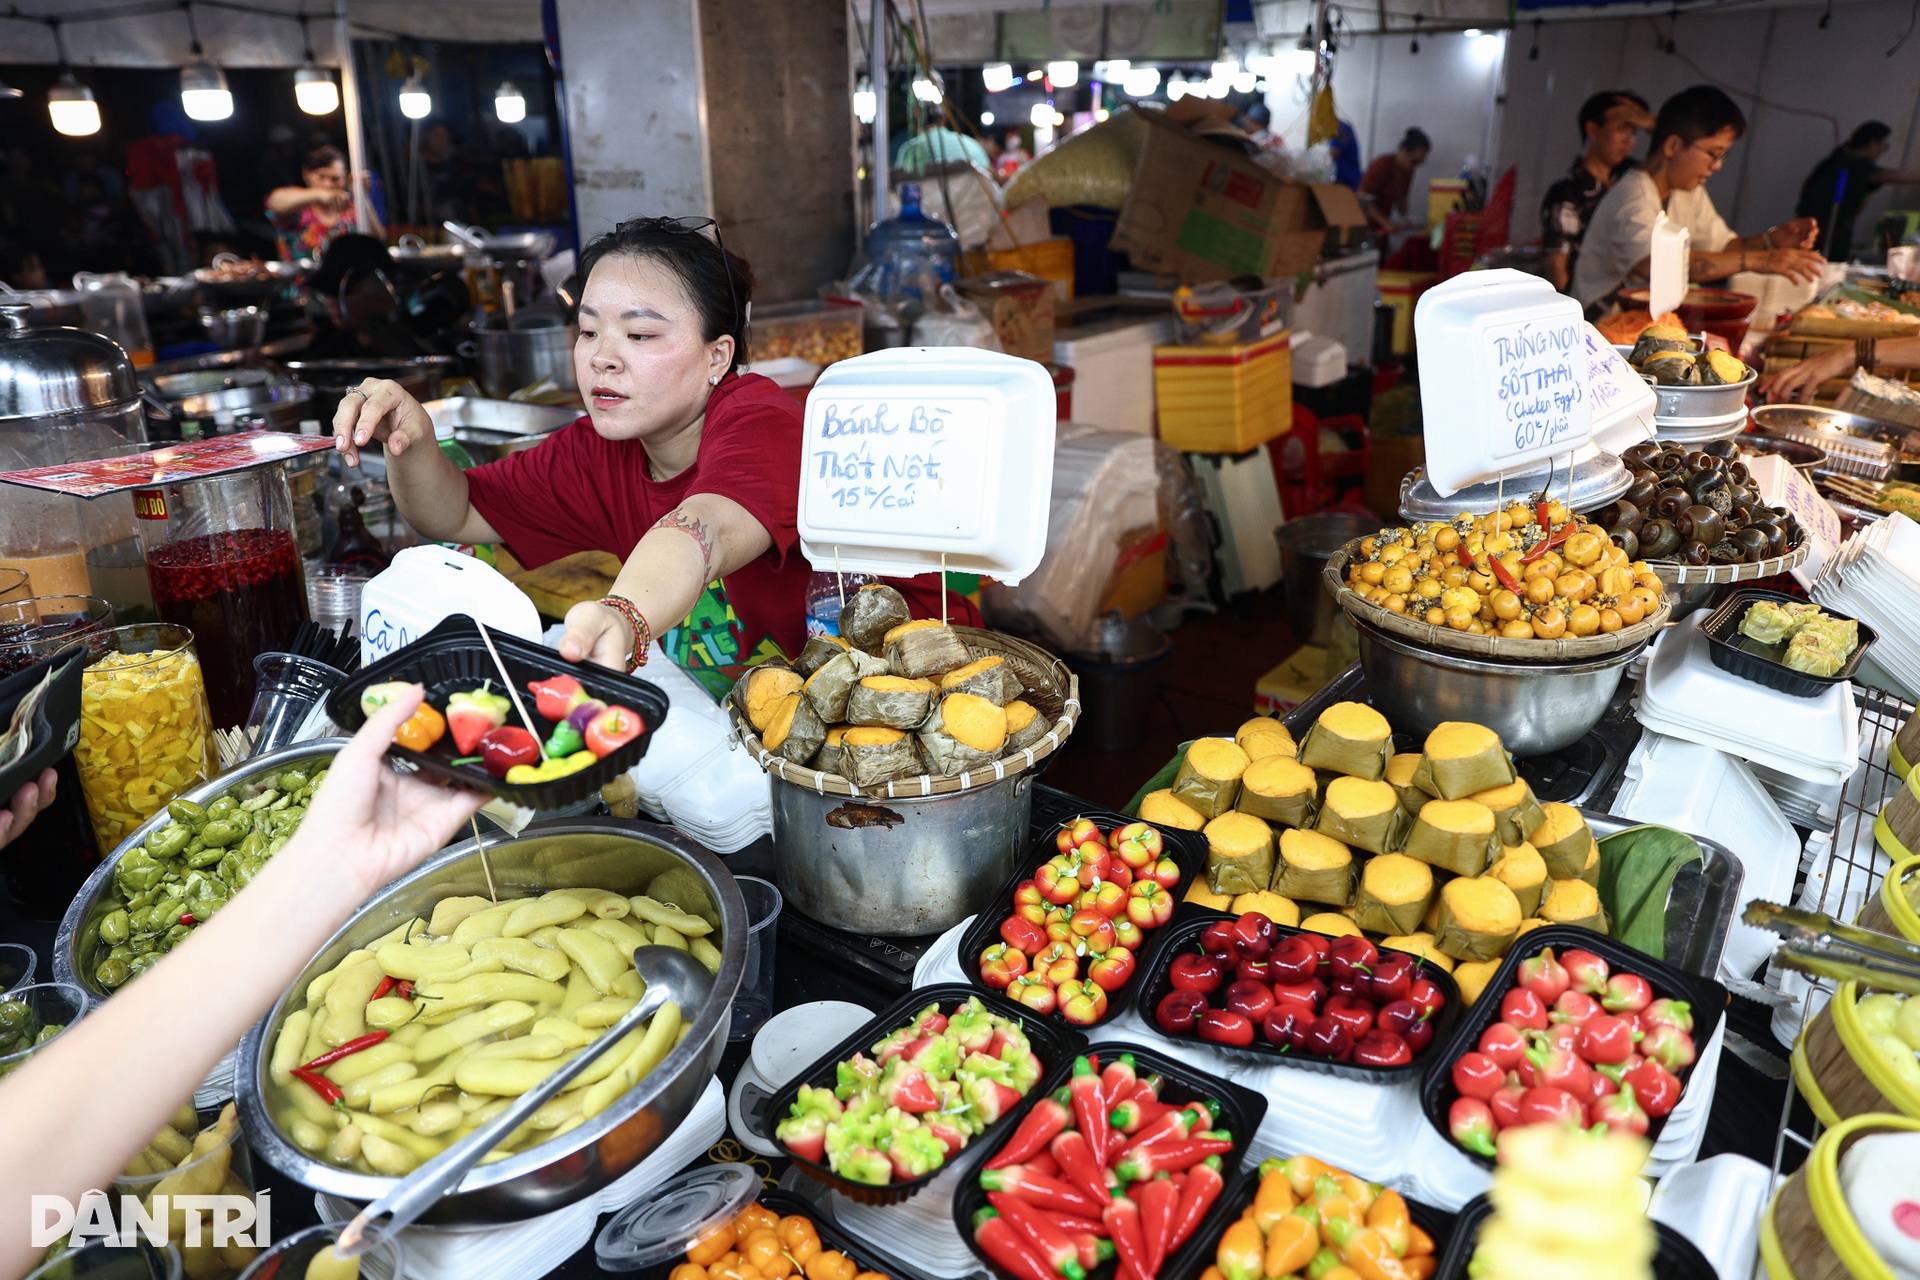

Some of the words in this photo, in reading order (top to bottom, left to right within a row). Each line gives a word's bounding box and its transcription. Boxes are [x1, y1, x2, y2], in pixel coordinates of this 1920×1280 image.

[1549, 323, 1580, 350] NON
[1498, 361, 1533, 400] SỐT
[822, 403, 899, 438] Bánh
[909, 405, 952, 435] Bò
[813, 440, 875, 480] Thốt
